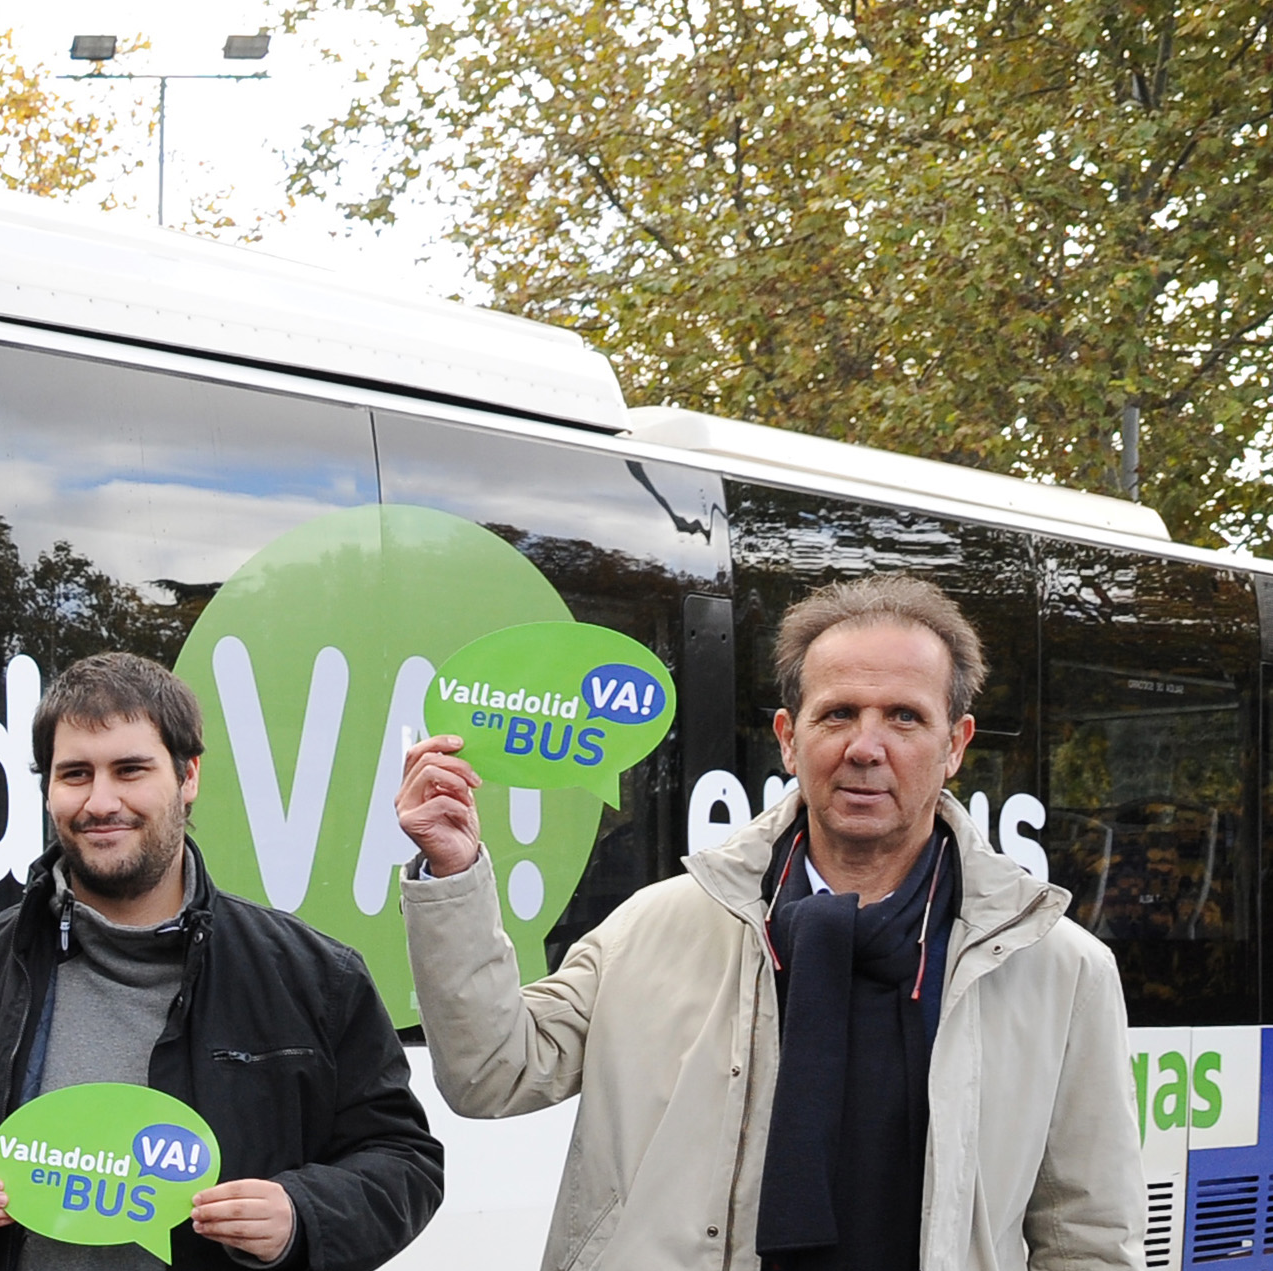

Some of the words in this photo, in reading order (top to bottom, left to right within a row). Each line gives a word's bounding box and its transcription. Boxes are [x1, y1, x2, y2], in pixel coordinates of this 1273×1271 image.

[438, 677, 580, 720] Valladolid
[591, 676, 655, 716] VA!
[471, 710, 503, 730] en
[504, 716, 605, 767] BUS
[0, 1135, 131, 1177] Valladolid
[141, 1136, 201, 1174] VA!
[31, 1168, 61, 1187] en
[62, 1174, 157, 1222] BUS
